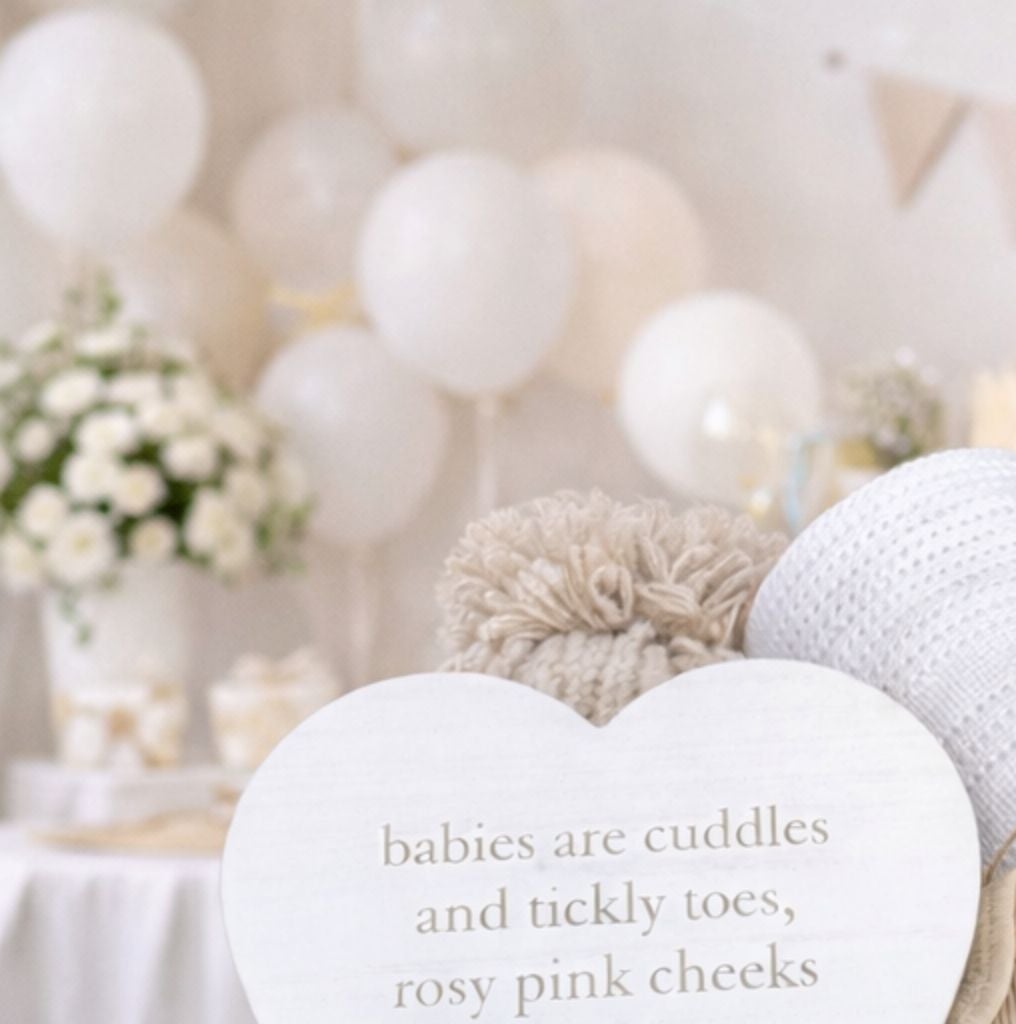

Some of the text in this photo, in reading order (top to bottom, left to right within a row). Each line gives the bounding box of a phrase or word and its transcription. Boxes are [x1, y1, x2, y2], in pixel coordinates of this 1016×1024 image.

[382, 805, 829, 866] babies are cuddles
[416, 880, 796, 937] and tickly toes,
[394, 942, 819, 1020] rosy pink cheeks
